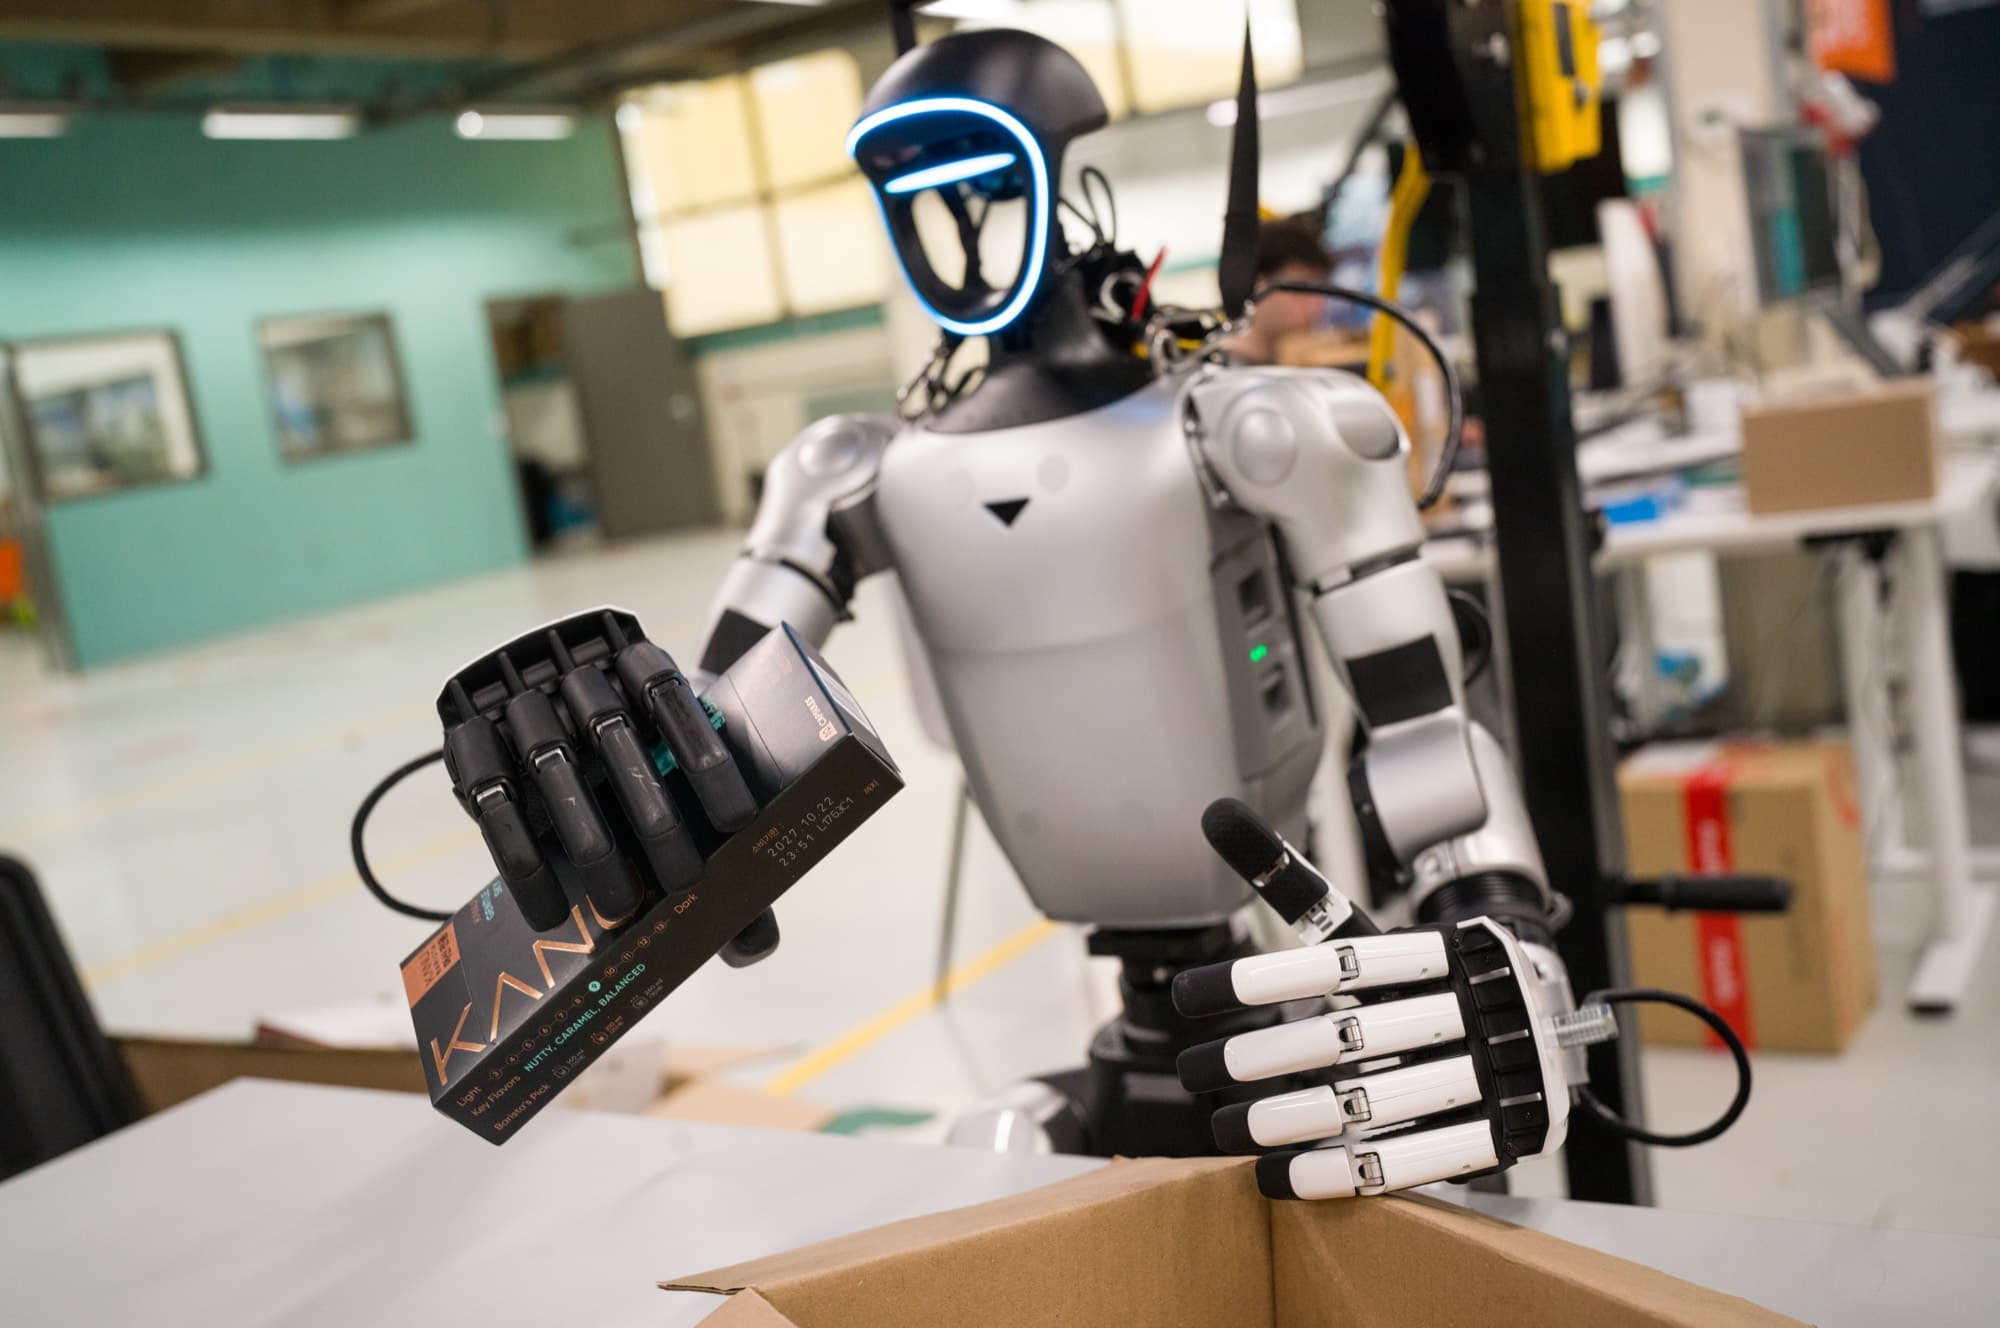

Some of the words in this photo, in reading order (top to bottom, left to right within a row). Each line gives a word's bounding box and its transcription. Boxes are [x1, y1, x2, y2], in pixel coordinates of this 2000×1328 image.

[456, 1086, 482, 1107] Light
[673, 893, 698, 914] Dark
[471, 1100, 491, 1116] Key
[487, 1075, 521, 1103] Flavors
[523, 1044, 557, 1072] NUTTY,
[554, 1008, 601, 1045] CARAMEL,
[598, 963, 646, 1007] BALANCED
[494, 1099, 532, 1130] Barista's
[528, 1083, 551, 1101] Pick
